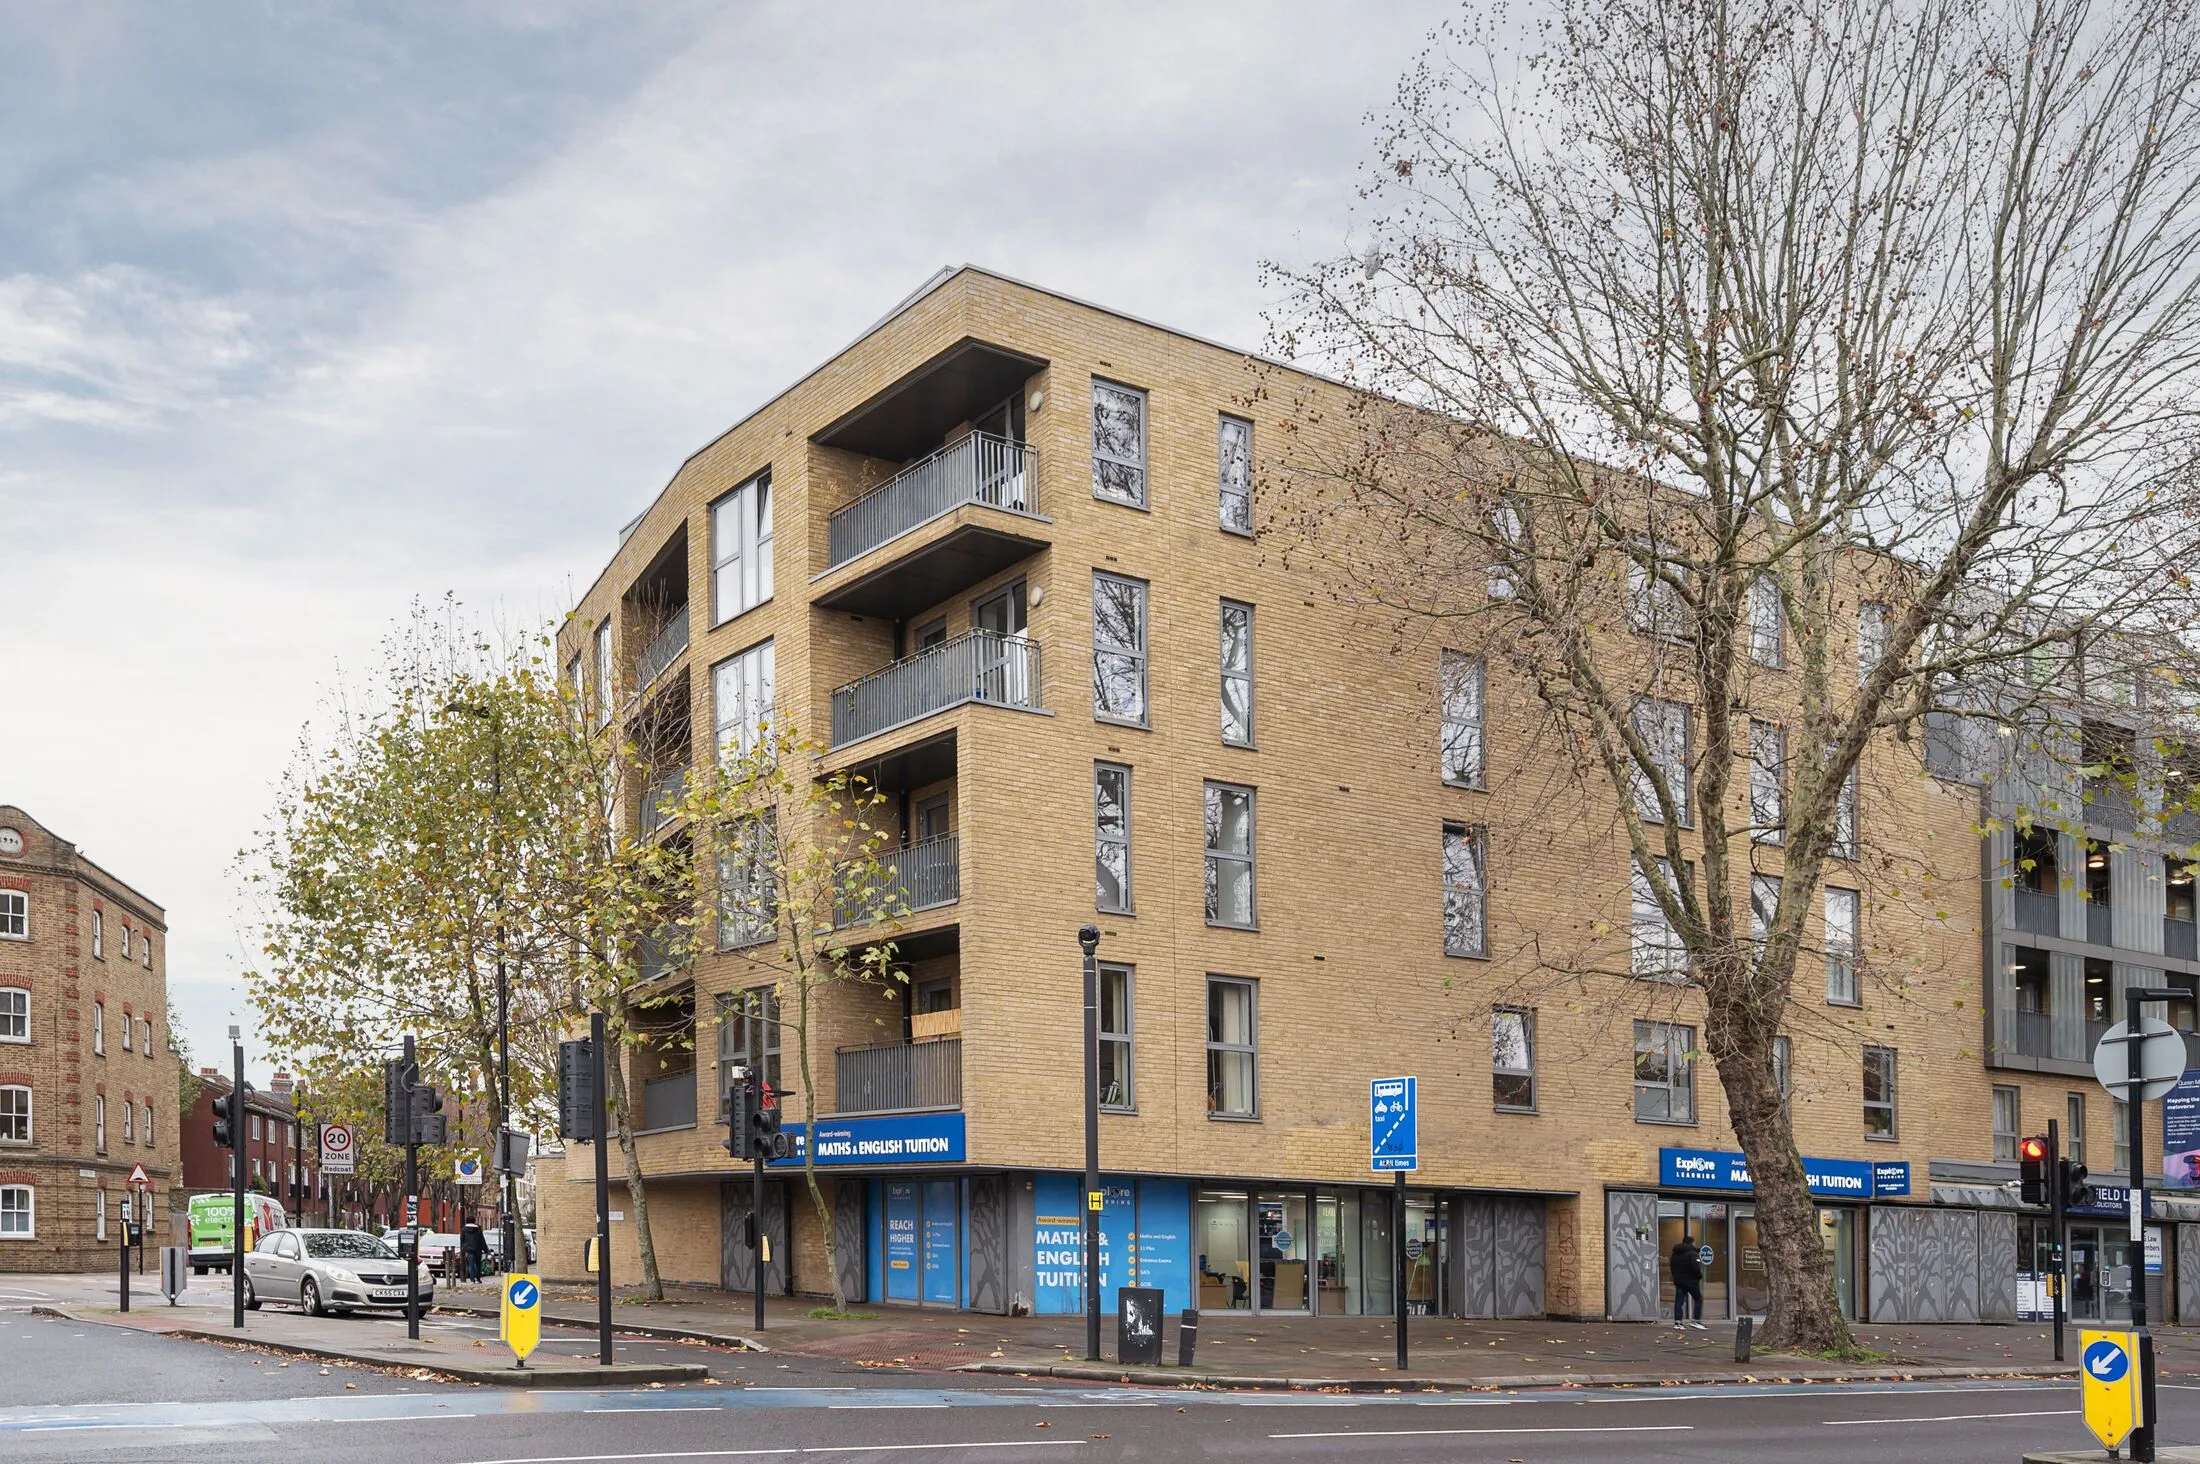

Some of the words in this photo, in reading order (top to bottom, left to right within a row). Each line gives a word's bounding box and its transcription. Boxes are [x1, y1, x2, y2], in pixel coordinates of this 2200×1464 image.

[328, 1133, 346, 1144] 20
[819, 1130, 851, 1138] Award-winning
[818, 1141, 851, 1156] MATHS
[852, 1145, 858, 1155] &
[858, 1139, 903, 1155] ENGLISH
[904, 1137, 949, 1153] TUITION
[325, 1152, 350, 1160] ZONE
[1394, 1159, 1410, 1167] times
[1676, 1157, 1715, 1171] Explore
[1676, 1172, 1716, 1180] LEARNING
[1876, 1167, 1905, 1176] Explore
[1821, 1175, 1862, 1189] TUITION
[1101, 1186, 1130, 1198] plore
[1090, 1194, 1101, 1208] H
[889, 1219, 914, 1231] REACH
[889, 1233, 914, 1244] HIGHER
[1037, 1251, 1110, 1267] ENGLIH
